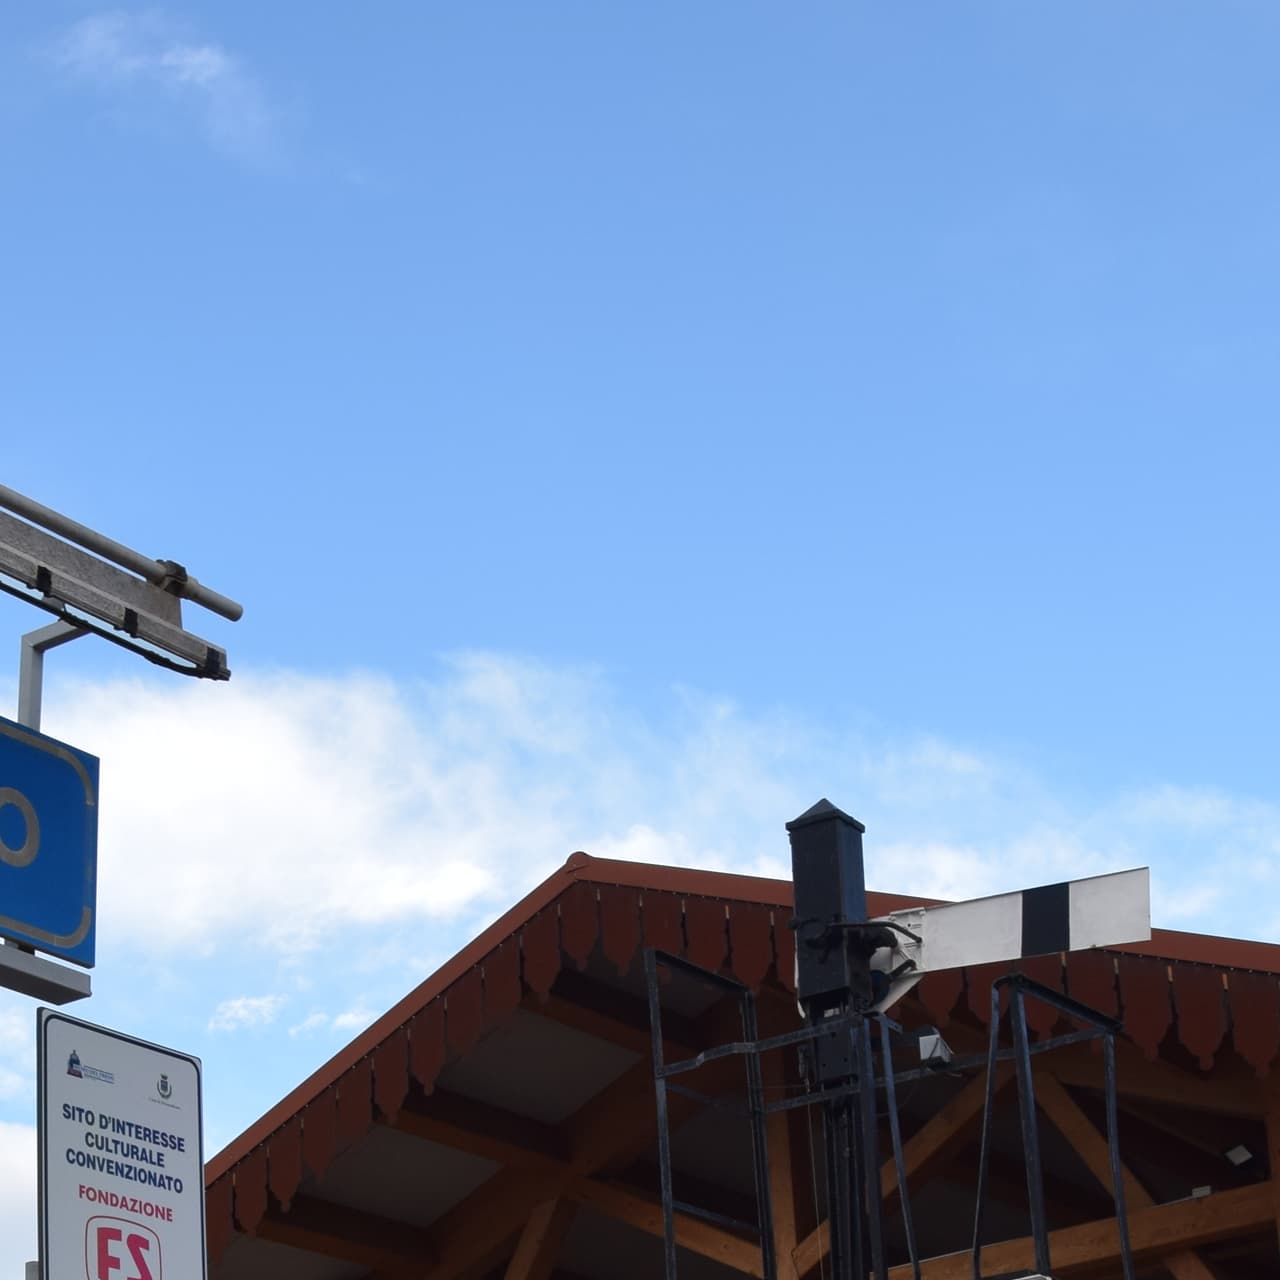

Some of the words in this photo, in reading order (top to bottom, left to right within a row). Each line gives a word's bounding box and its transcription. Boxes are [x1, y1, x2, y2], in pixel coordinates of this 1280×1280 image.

[62, 1103, 95, 1126] SITO
[99, 1114, 185, 1152] D'INTERESSE
[66, 1148, 183, 1194] CONVENZIONATO
[85, 1132, 165, 1168] CULTURALE
[79, 1184, 173, 1222] FONDAZIONE
